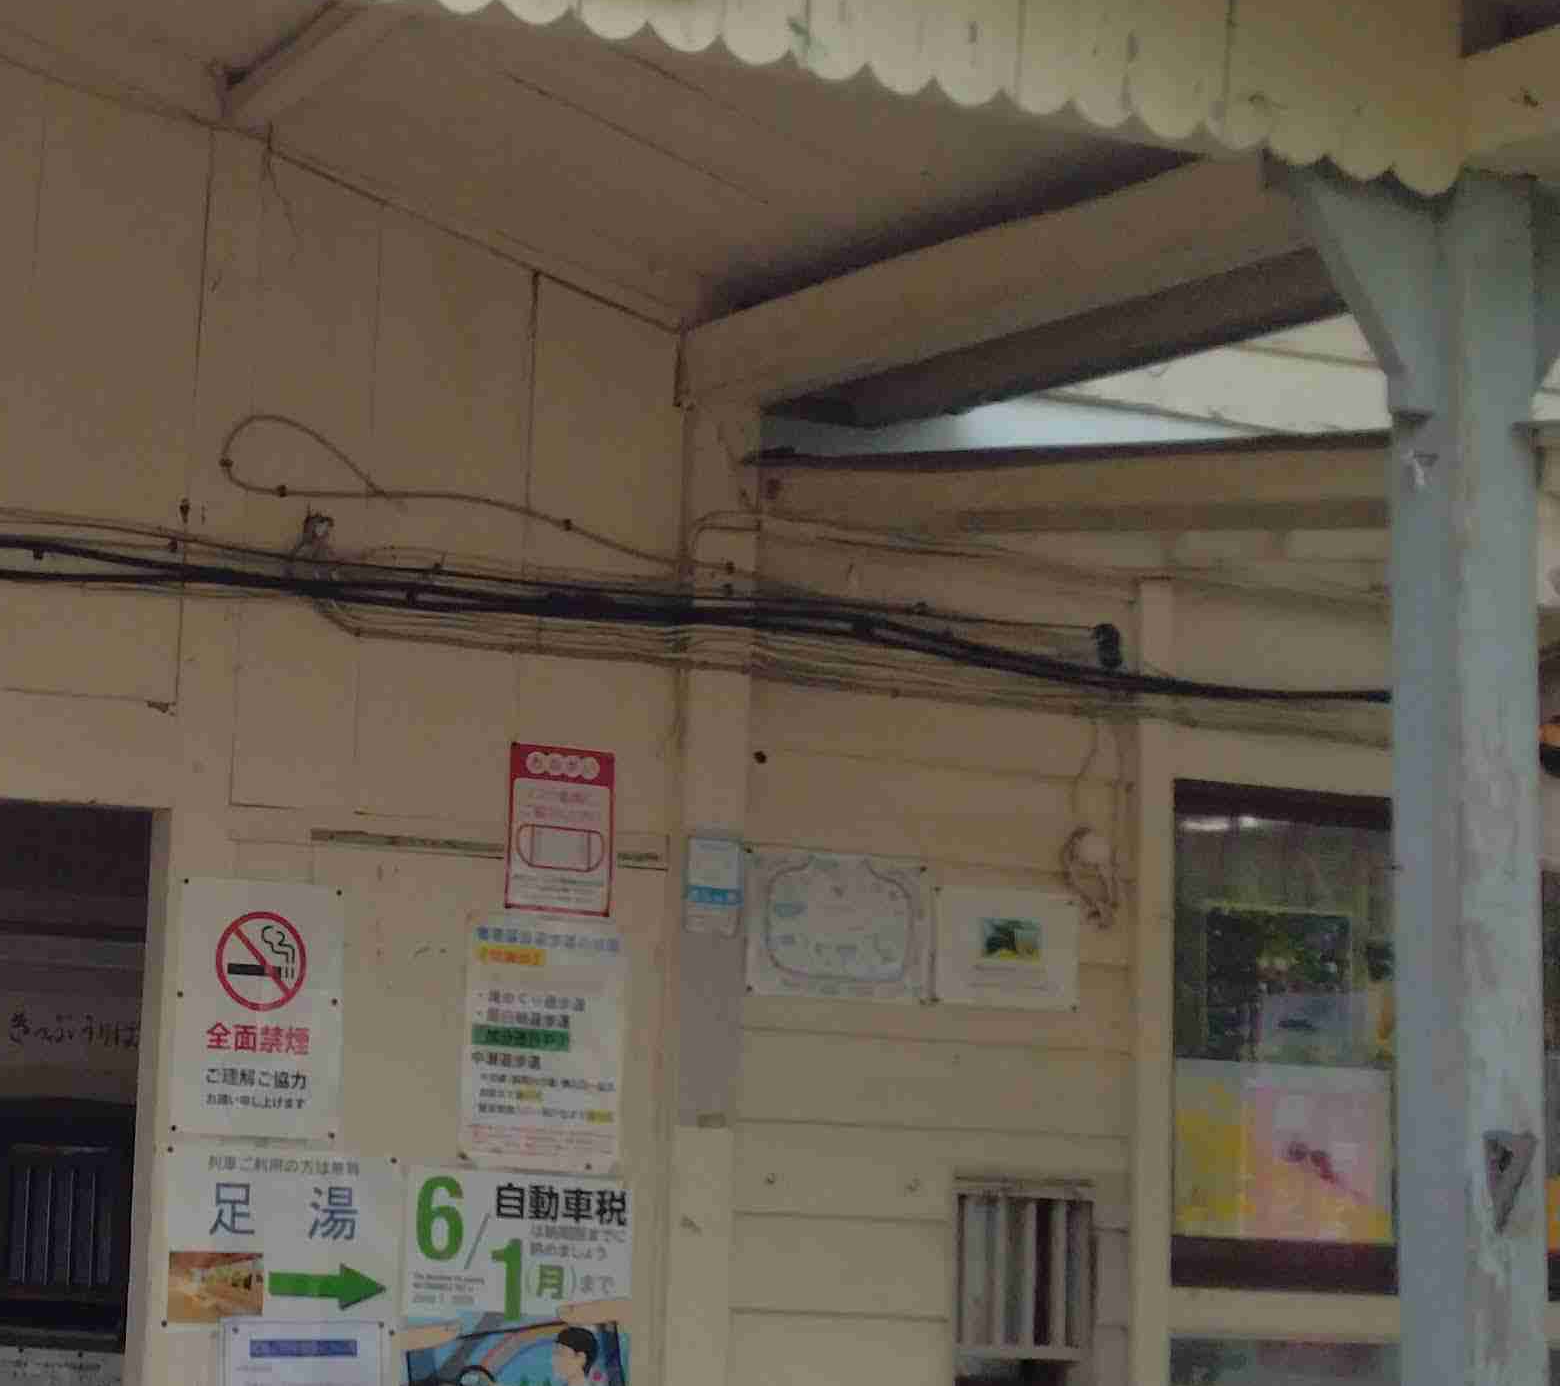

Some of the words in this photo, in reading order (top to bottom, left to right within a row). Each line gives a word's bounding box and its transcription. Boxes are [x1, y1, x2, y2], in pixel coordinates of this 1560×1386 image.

[206, 1021, 310, 1055] 全面禁煙
[206, 1068, 307, 1090] ご理解ご協力
[209, 1182, 359, 1240] 足湯
[495, 1182, 627, 1226] 自動車税
